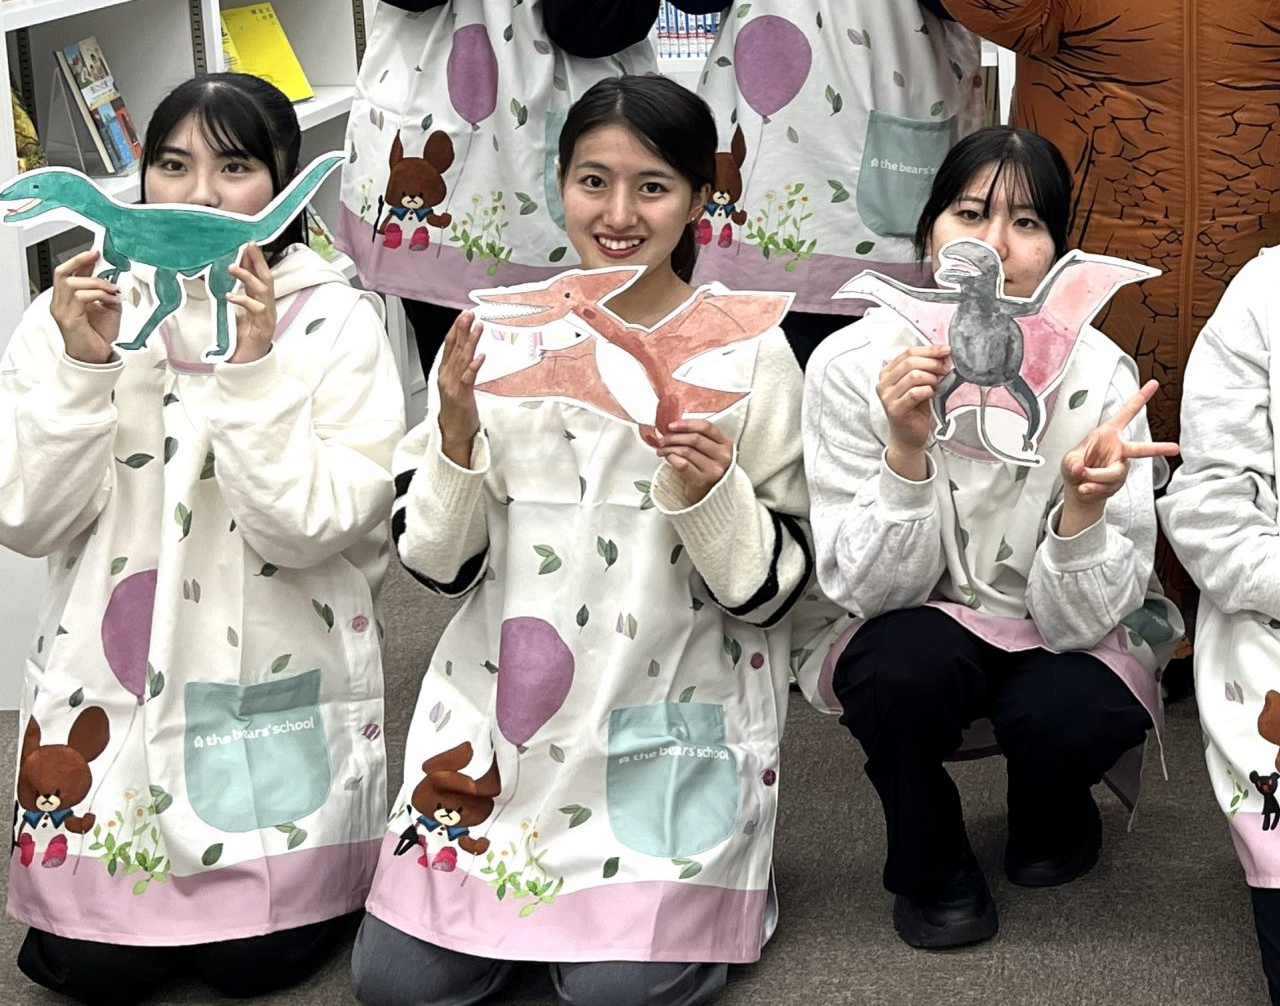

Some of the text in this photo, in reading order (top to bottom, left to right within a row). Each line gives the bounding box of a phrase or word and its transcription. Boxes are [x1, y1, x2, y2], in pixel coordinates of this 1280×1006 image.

[880, 158, 898, 171] the
[205, 716, 315, 746] the bears' school
[633, 750, 658, 761] the
[697, 745, 730, 761] school
